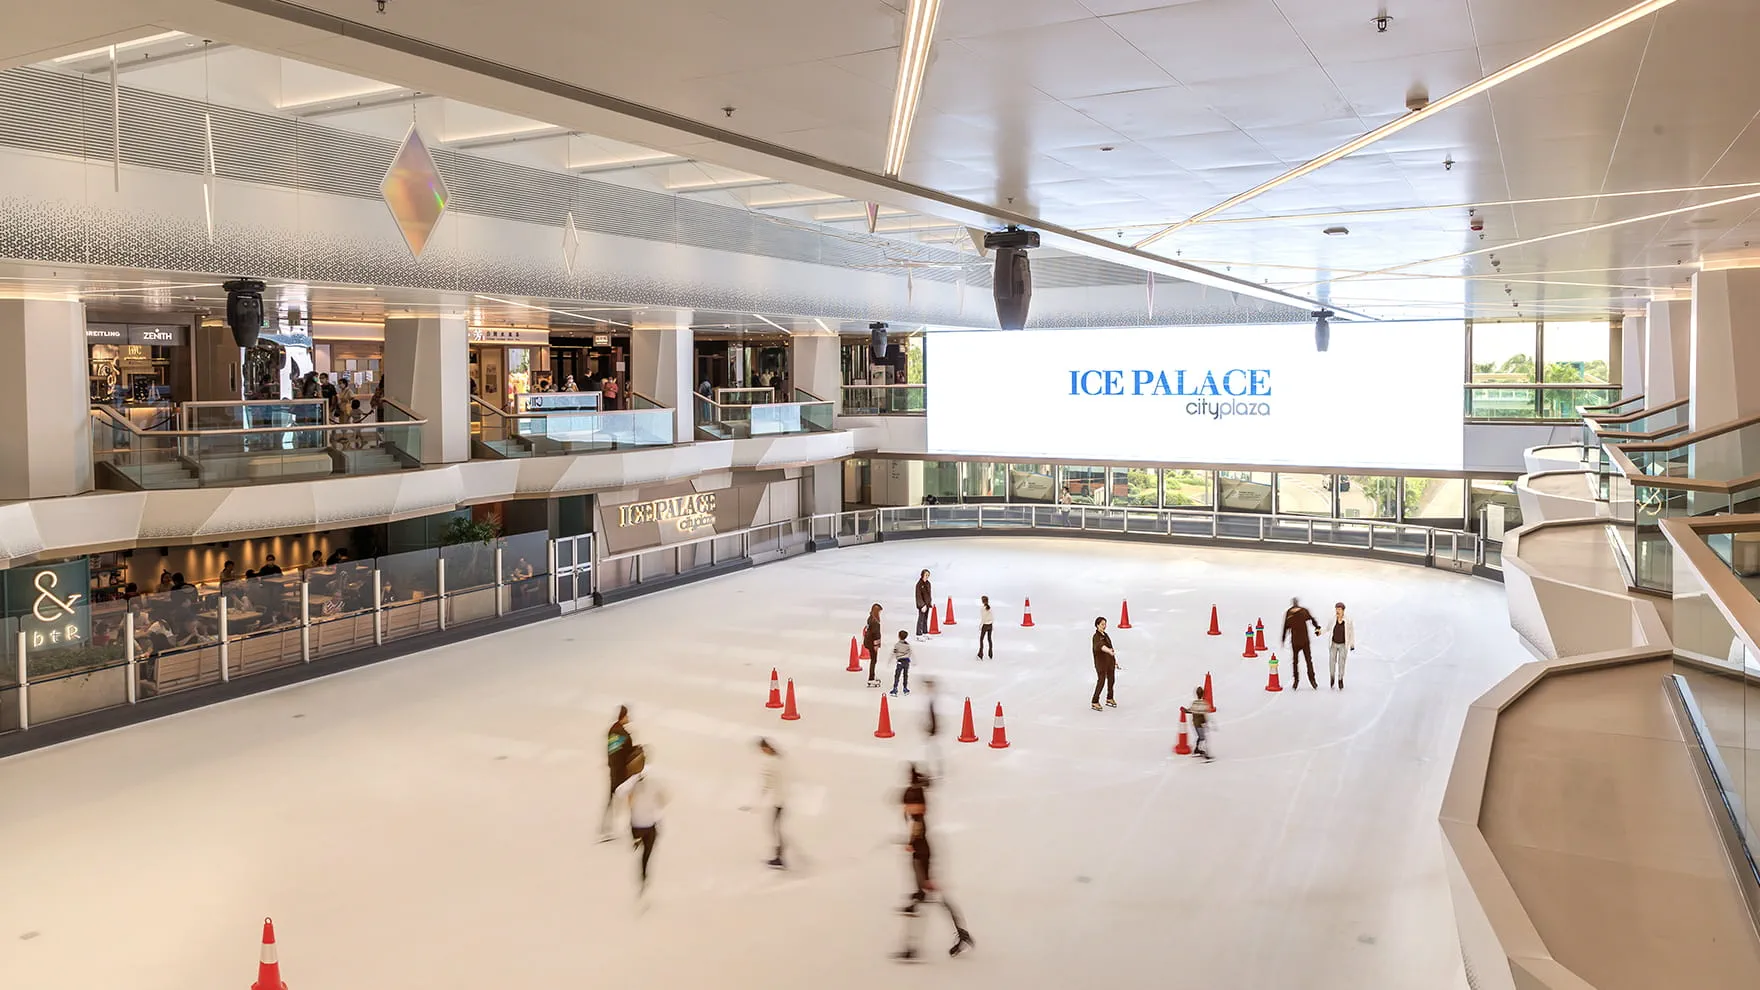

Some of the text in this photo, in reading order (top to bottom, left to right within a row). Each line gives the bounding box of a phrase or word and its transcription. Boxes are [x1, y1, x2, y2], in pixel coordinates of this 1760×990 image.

[143, 331, 173, 340] ZENITH
[1068, 369, 1272, 396] ICE PALACE
[1186, 398, 1271, 420] cityplaza
[619, 492, 717, 527] ICE PALACE
[33, 570, 82, 622] &
